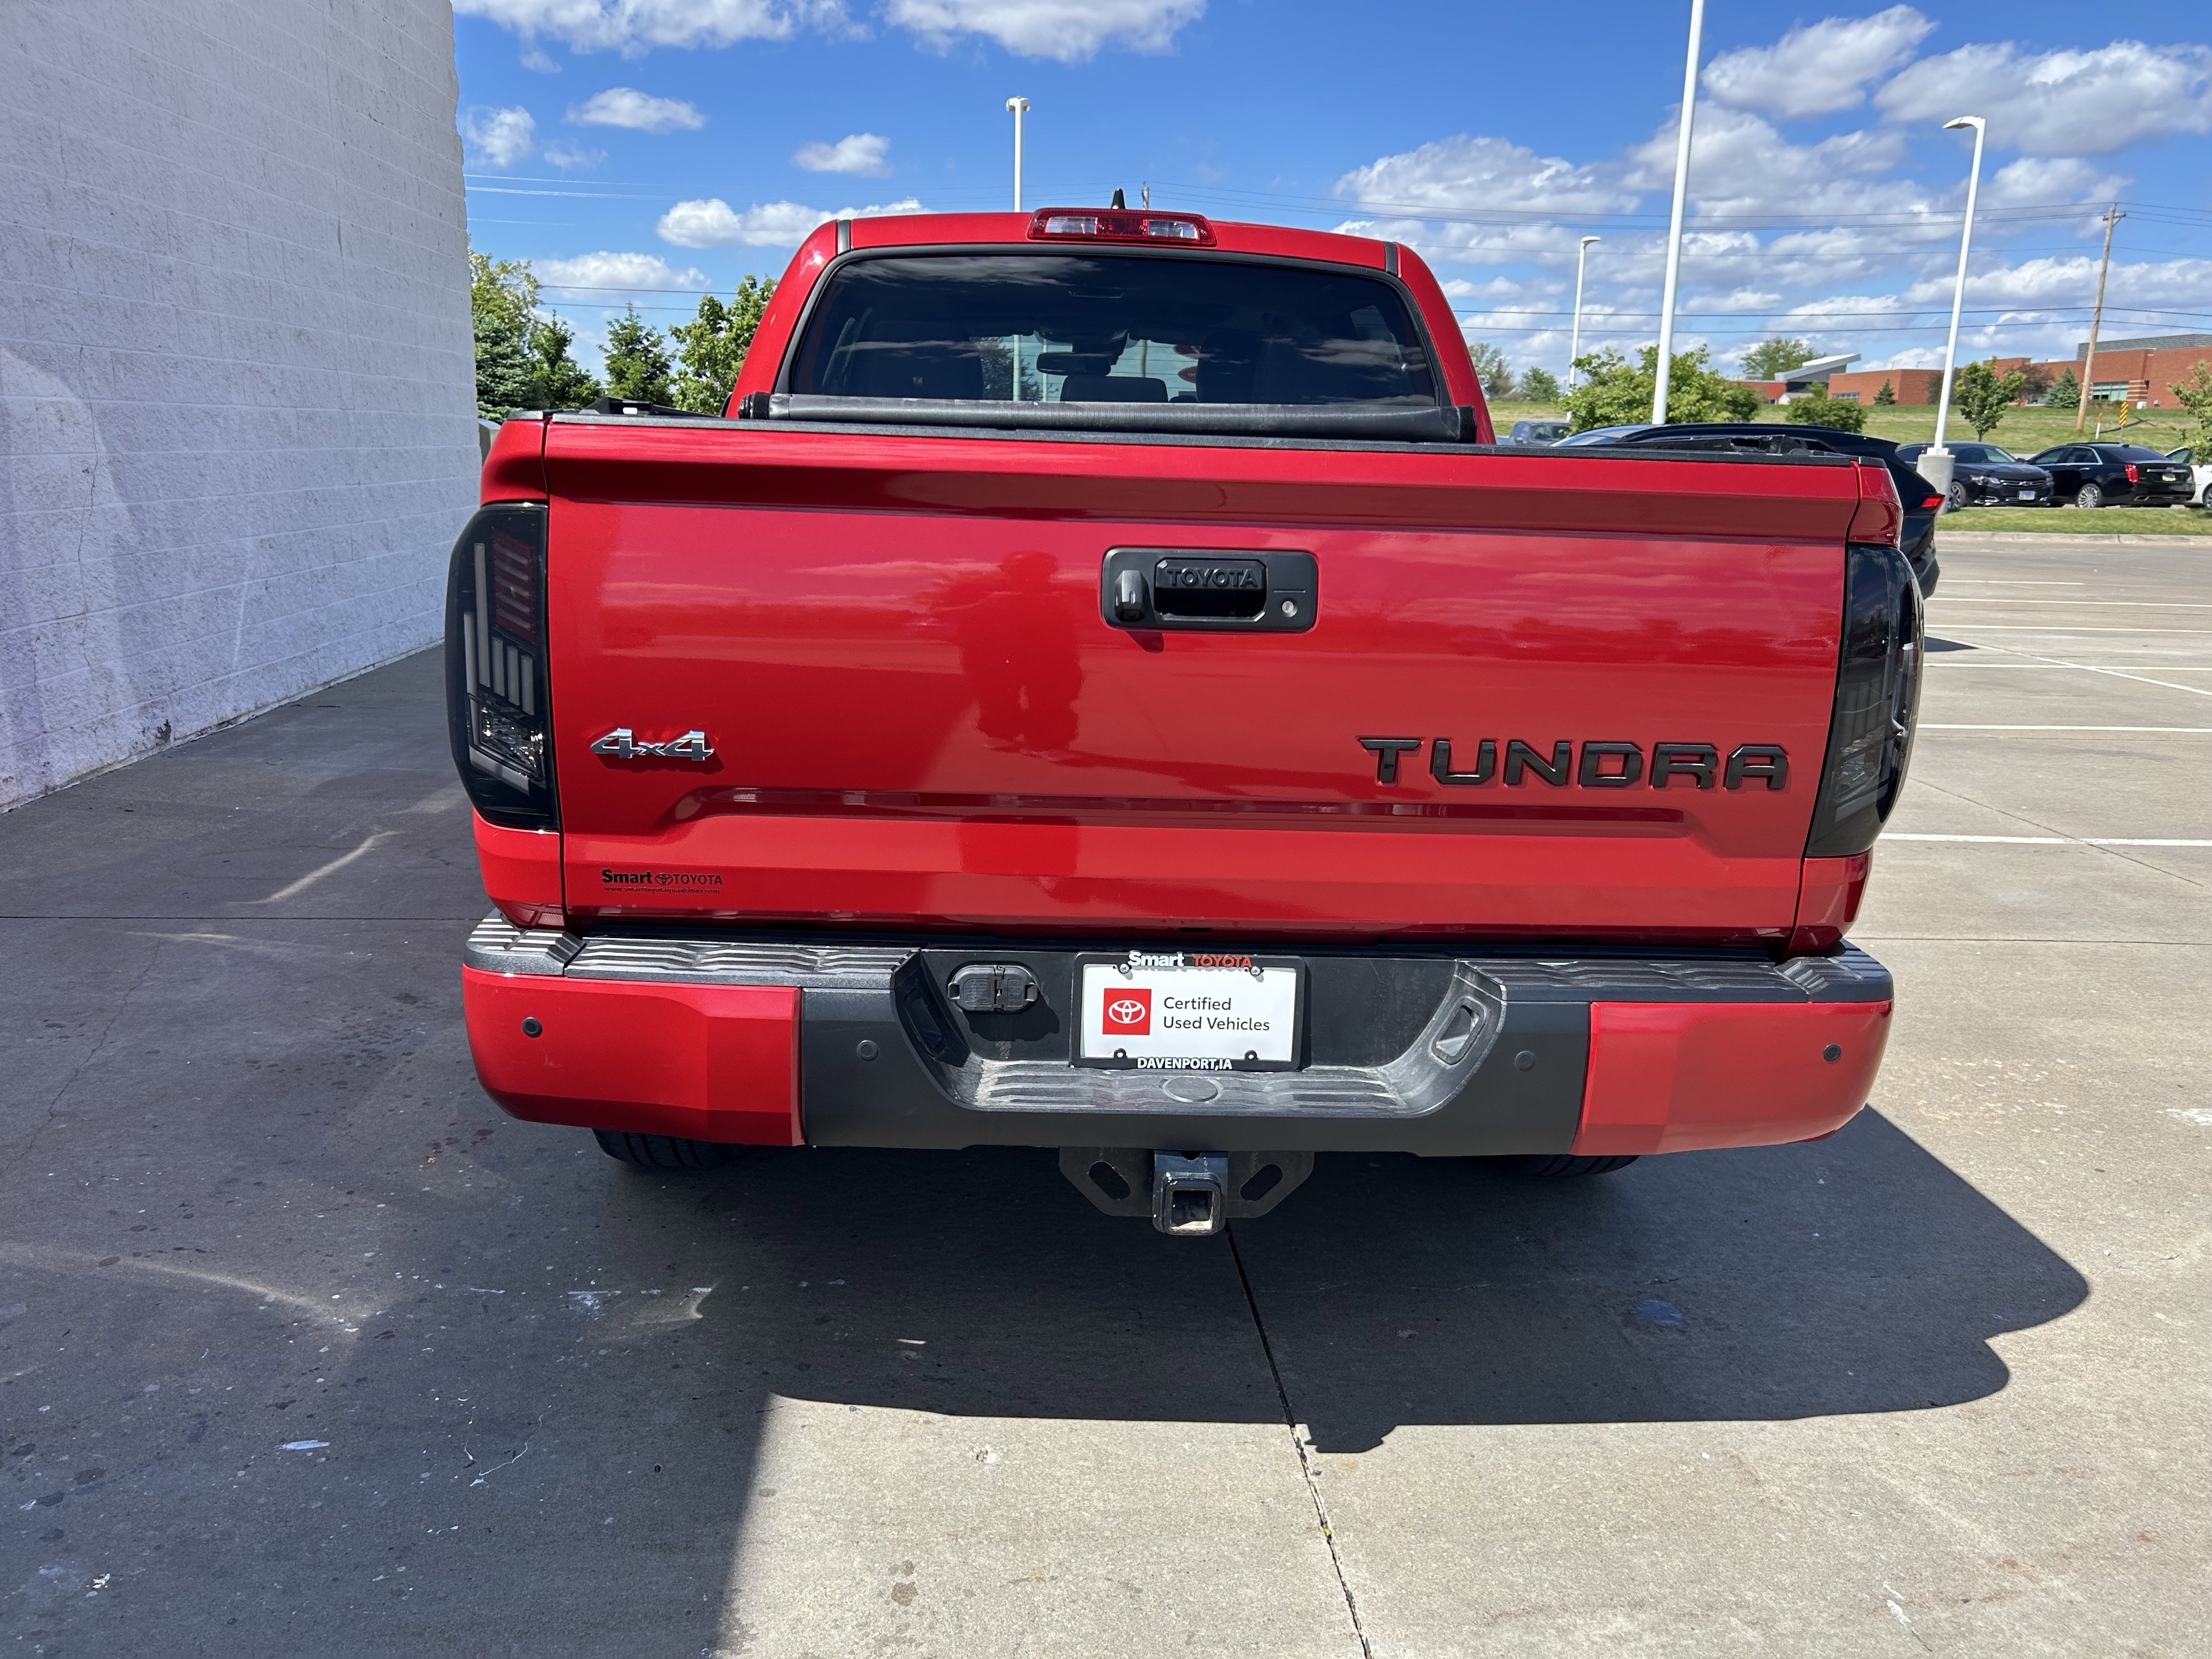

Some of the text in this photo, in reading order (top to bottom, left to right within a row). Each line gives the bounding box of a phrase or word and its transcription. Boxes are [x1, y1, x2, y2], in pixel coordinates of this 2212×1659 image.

[1167, 567, 1258, 588] TOYOTA
[591, 728, 714, 761] 4x4
[1357, 737, 1790, 790] TUNDRA
[601, 868, 723, 885] Smart TOYOTA
[1127, 950, 1252, 968] Smart TOYOTA
[1163, 997, 1232, 1011] Certified
[1163, 1017, 1270, 1031] Used Vehicles
